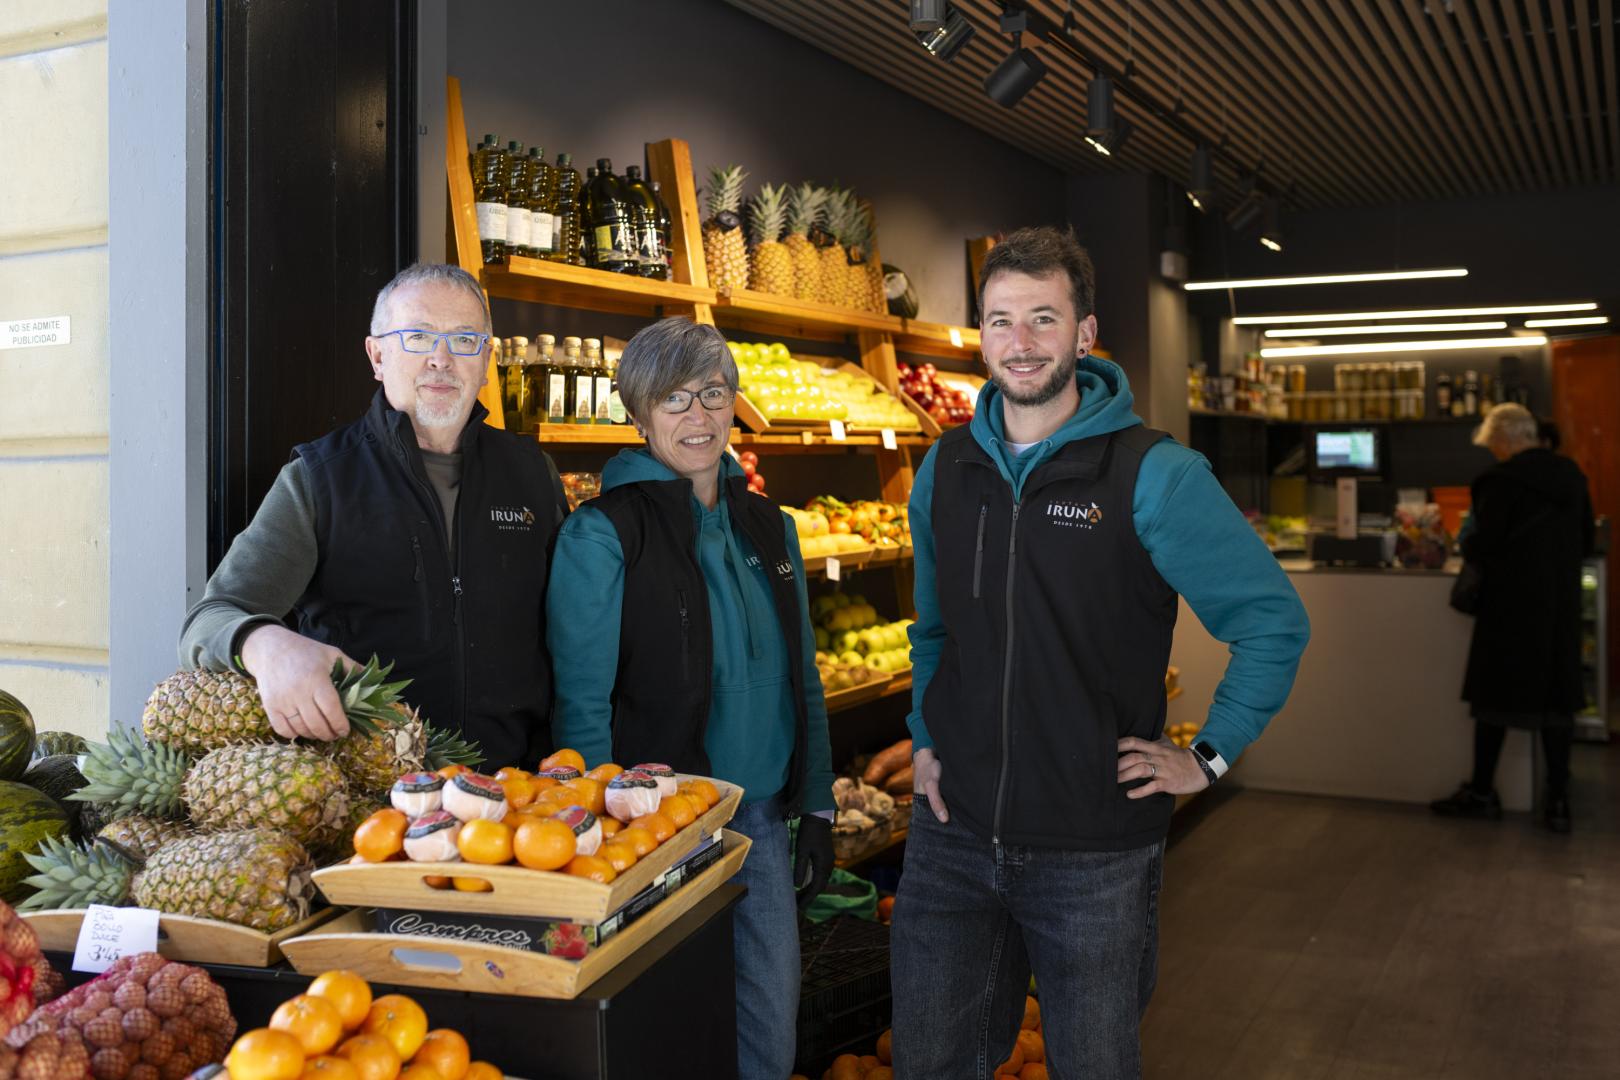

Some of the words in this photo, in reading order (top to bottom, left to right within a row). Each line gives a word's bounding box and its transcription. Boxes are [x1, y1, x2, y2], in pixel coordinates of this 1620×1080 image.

[9, 324, 20, 333] NO
[21, 322, 31, 332] SE
[33, 320, 61, 331] ADMITE
[12, 333, 57, 345] PUBLICIDAD
[389, 913, 532, 946] Campres
